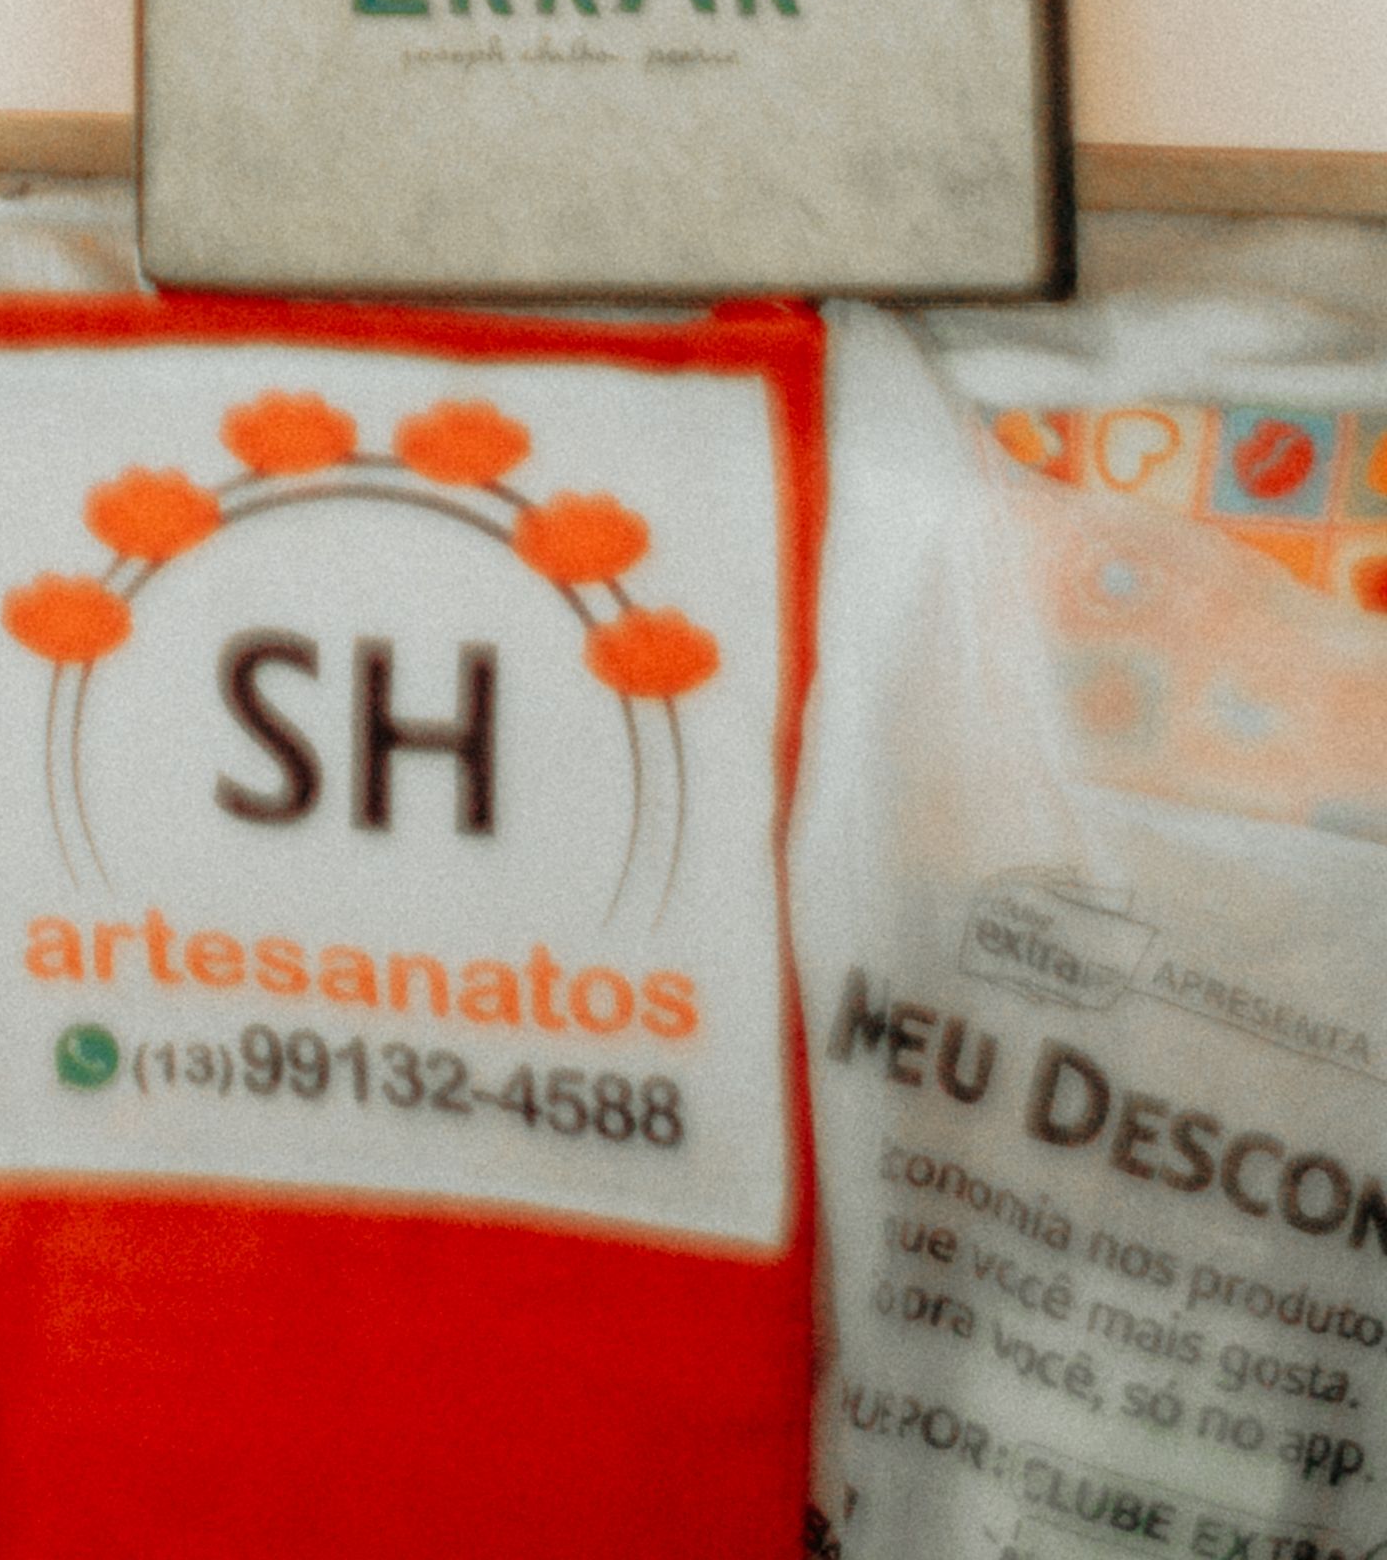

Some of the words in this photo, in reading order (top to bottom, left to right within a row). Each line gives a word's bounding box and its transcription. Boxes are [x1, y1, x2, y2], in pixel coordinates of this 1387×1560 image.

[213, 626, 500, 835] SH
[24, 906, 699, 1038] artesanatos
[1152, 959, 1371, 1065] APRESENTA
[1087, 1225, 1179, 1290] nos
[1187, 1261, 1387, 1348] produto
[993, 1321, 1105, 1414] você,
[1125, 1378, 1184, 1429] só
[1197, 1404, 1265, 1452] no
[1279, 1429, 1374, 1487] app.
[1087, 1298, 1206, 1366] mais
[1217, 1341, 1361, 1410] gosta.
[1023, 1456, 1179, 1542] CLUBE
